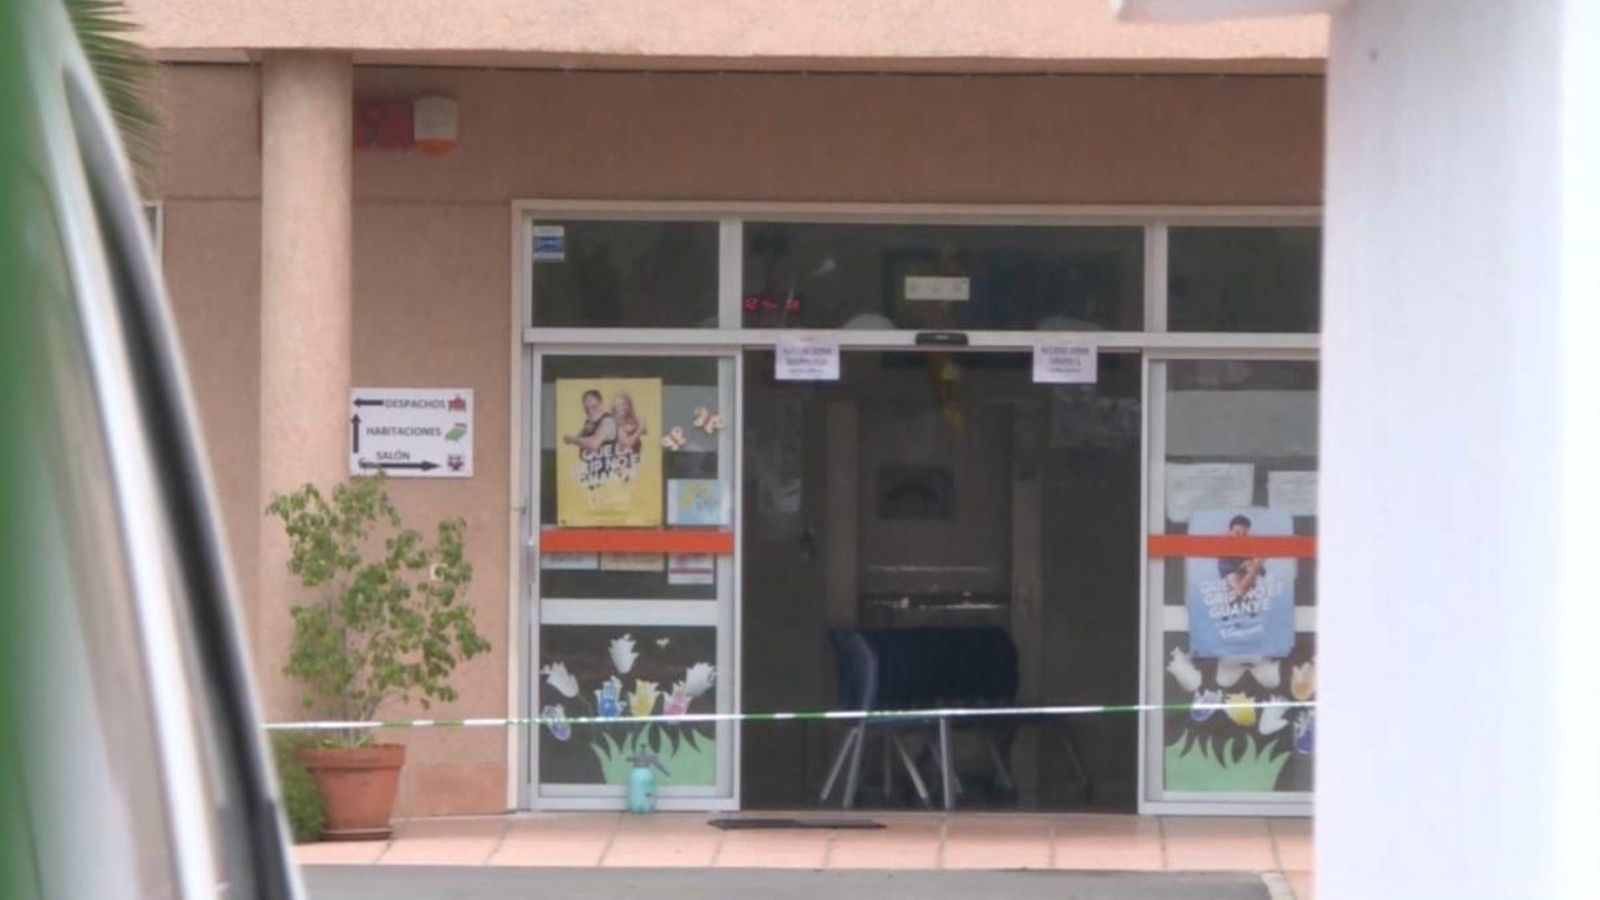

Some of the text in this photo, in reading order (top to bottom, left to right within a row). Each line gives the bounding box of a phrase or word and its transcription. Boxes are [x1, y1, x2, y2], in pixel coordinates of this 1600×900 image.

[385, 398, 446, 409] DESPACHOS
[366, 426, 442, 437] HABITACIONES
[376, 448, 410, 460] SALÓN
[1208, 597, 1271, 619] GUANYE
